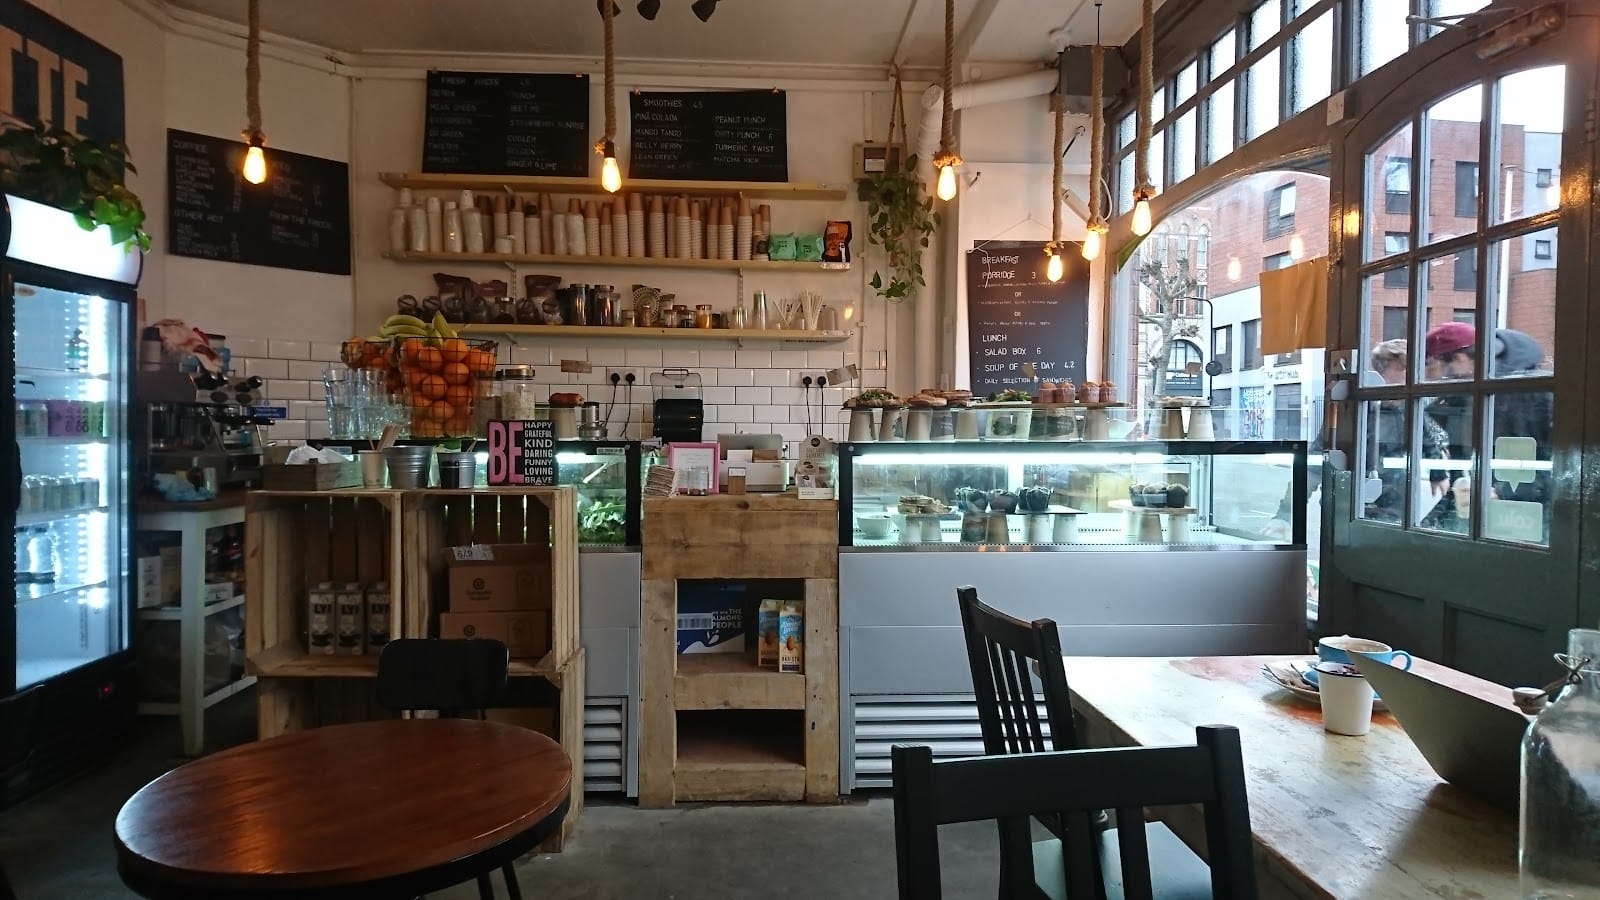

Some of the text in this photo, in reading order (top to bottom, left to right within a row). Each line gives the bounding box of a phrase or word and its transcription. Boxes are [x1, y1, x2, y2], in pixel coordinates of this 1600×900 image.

[652, 113, 679, 121] COLADA
[715, 116, 740, 124] PEANUT
[635, 128, 659, 137] MANGO
[714, 143, 776, 154] TURMERIC TWIST
[982, 255, 1020, 265] BREAKFAST
[982, 271, 1037, 280] PORRIDGE 3
[982, 334, 1008, 343] LUNCH
[984, 347, 1008, 356] SALAD
[1012, 347, 1027, 356] BOX
[985, 363, 1005, 373] SOUP
[1009, 362, 1019, 371] OF
[1041, 361, 1056, 370] DAY
[524, 430, 553, 438] GRATEFUL
[524, 439, 553, 448] KIND
[489, 421, 524, 484] BE
[524, 449, 553, 458] DARING
[524, 467, 553, 476] LOVING
[524, 476, 553, 484] BRAVE
[712, 621, 743, 629] PEOPLE
